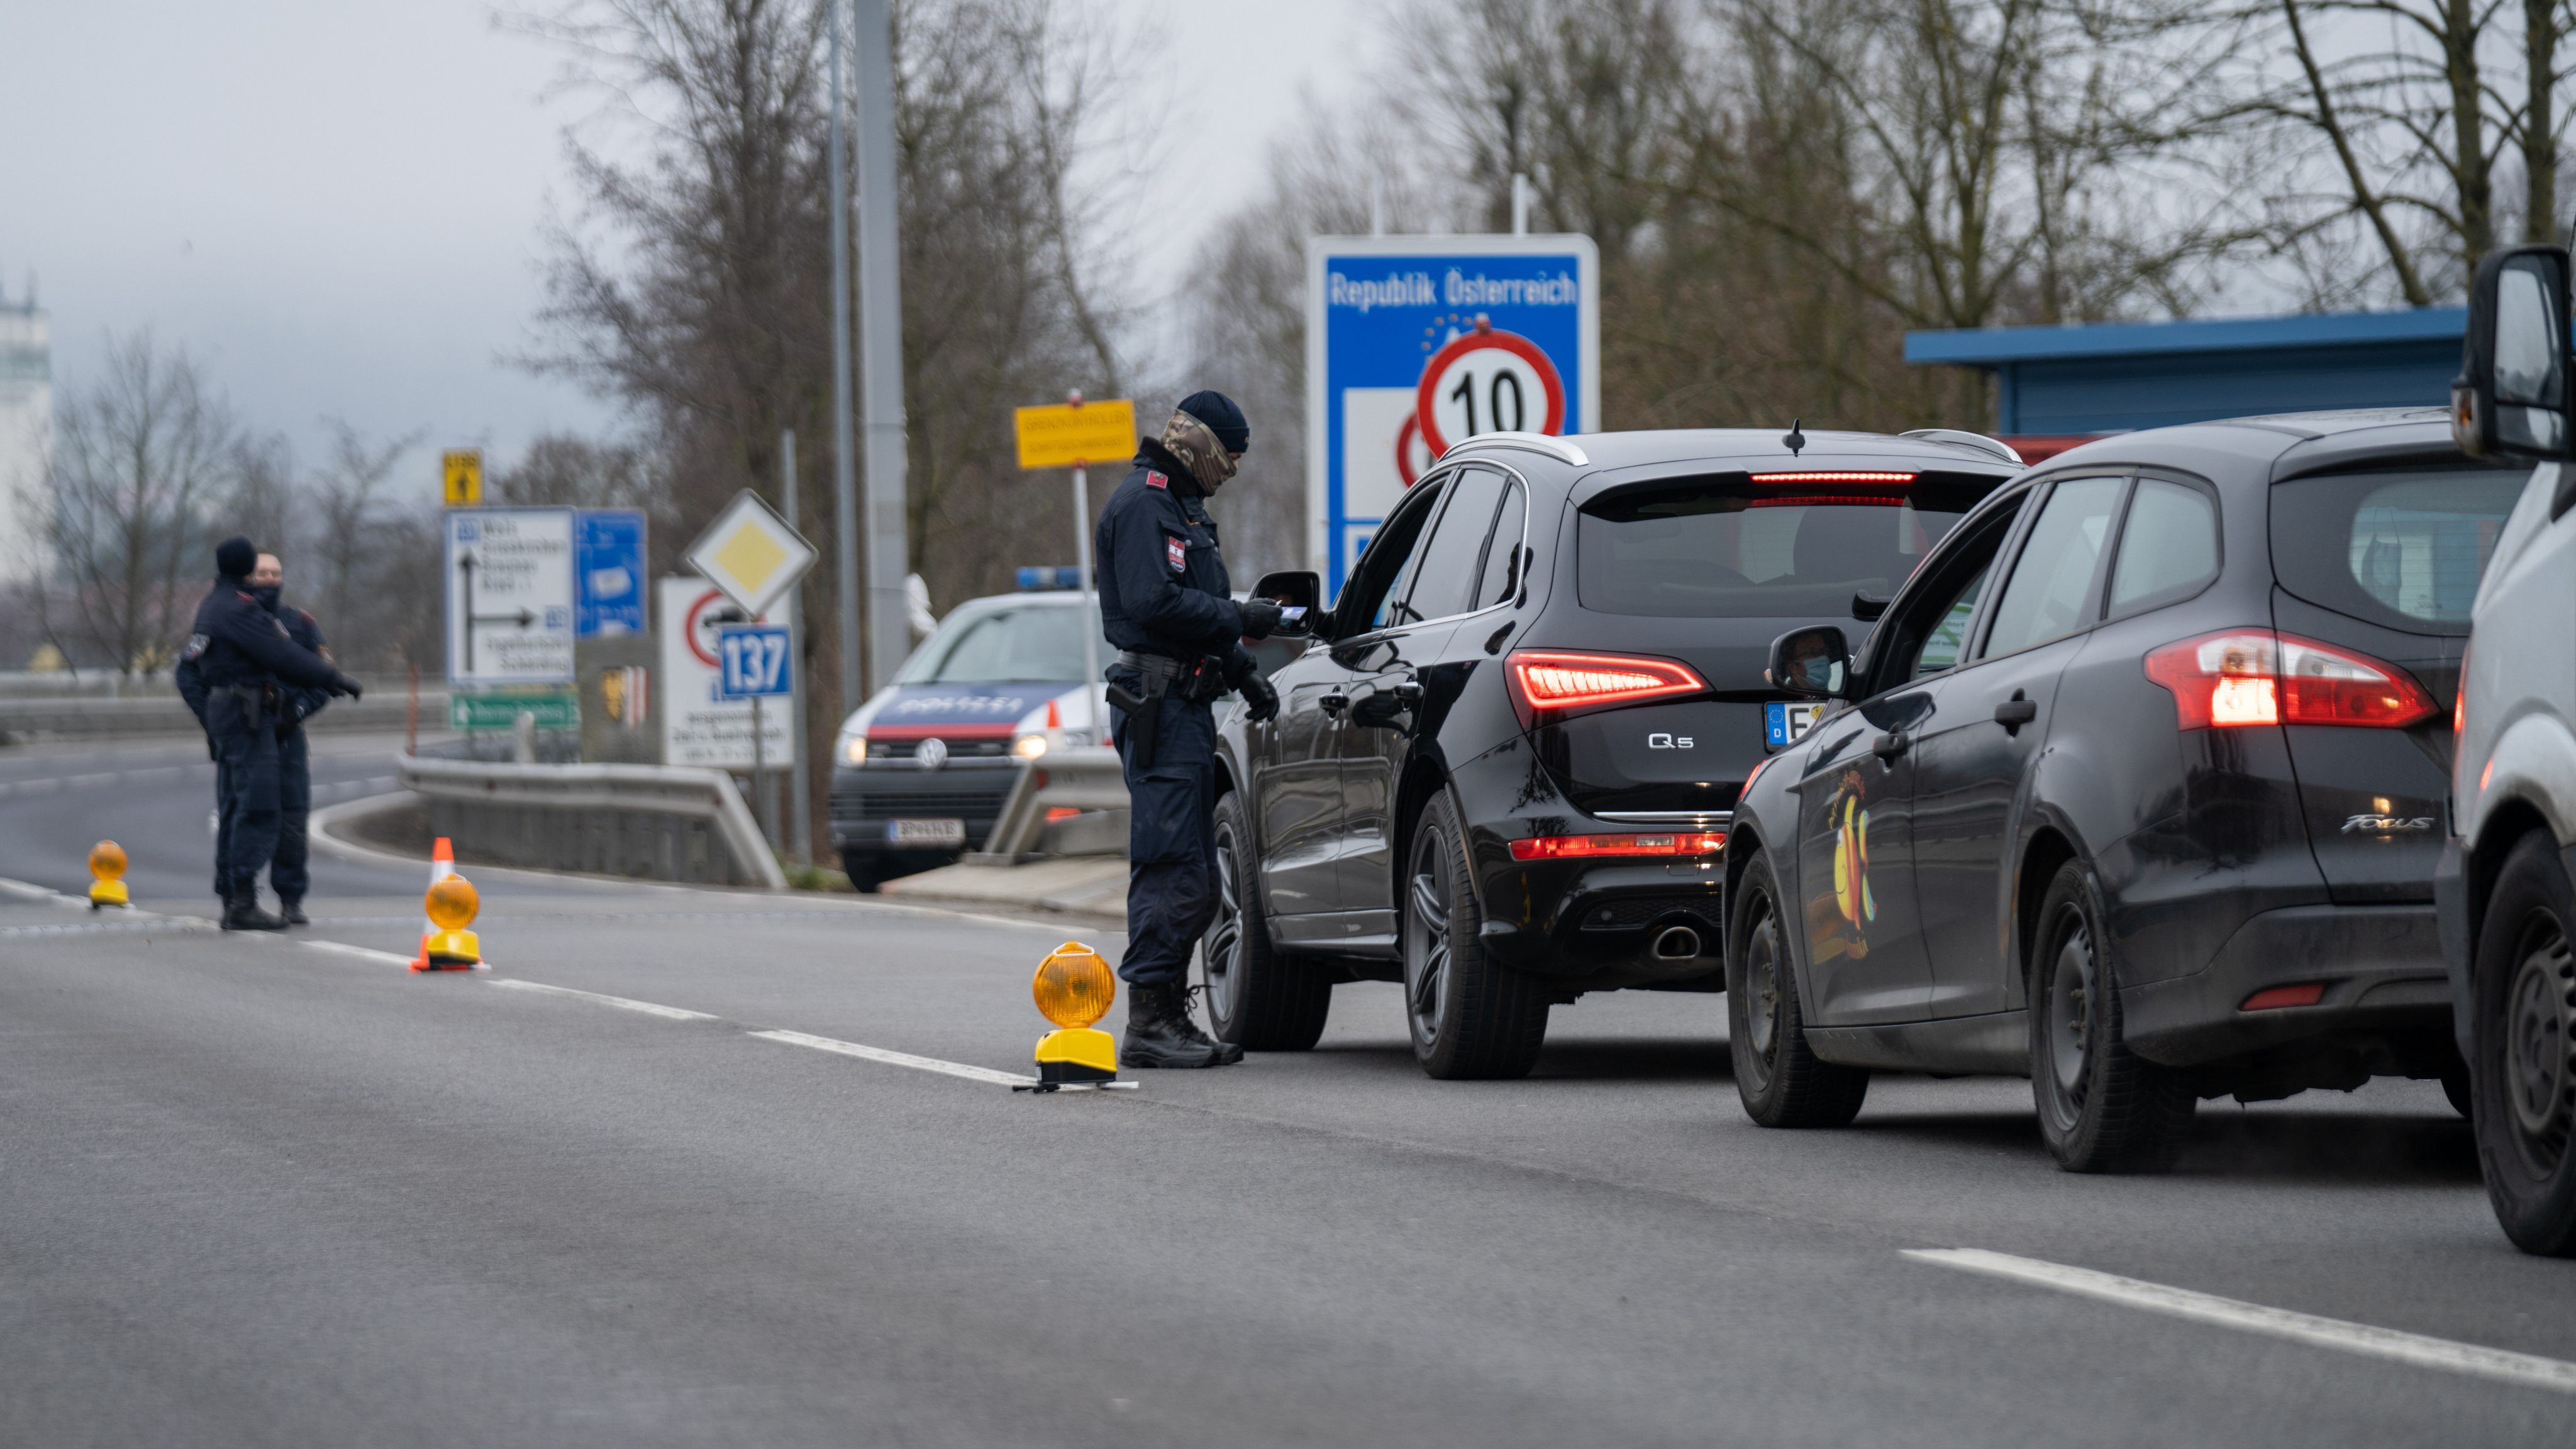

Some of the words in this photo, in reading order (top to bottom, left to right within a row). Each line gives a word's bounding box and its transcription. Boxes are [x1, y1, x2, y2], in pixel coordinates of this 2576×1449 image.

[1329, 272, 1438, 314] Republik
[1444, 266, 1577, 306] Österreich
[1452, 369, 1525, 436] 10
[725, 634, 786, 691] 137
[1774, 728, 1781, 738] D
[1789, 708, 1809, 739] F
[1648, 733, 1694, 750] Q5
[2340, 814, 2436, 835] Focus
